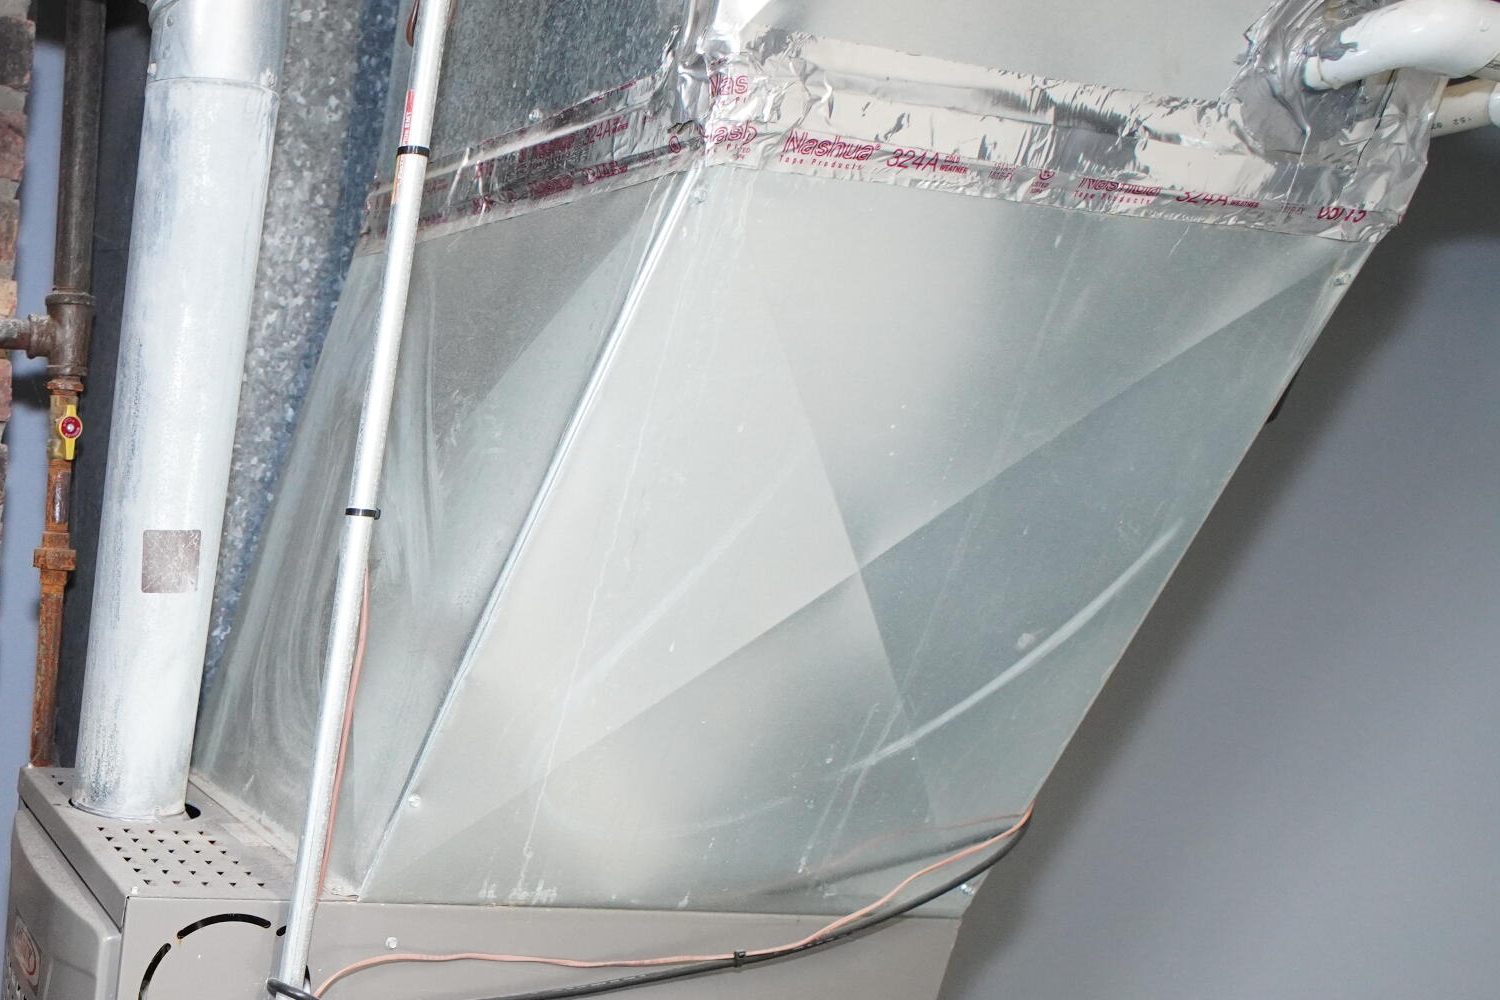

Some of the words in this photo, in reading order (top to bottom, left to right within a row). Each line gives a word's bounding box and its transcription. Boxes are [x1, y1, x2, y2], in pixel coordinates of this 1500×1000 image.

[779, 155, 804, 166] Tape
[811, 158, 865, 170] Products
[782, 129, 875, 161] Nashua
[886, 148, 939, 172] 324A
